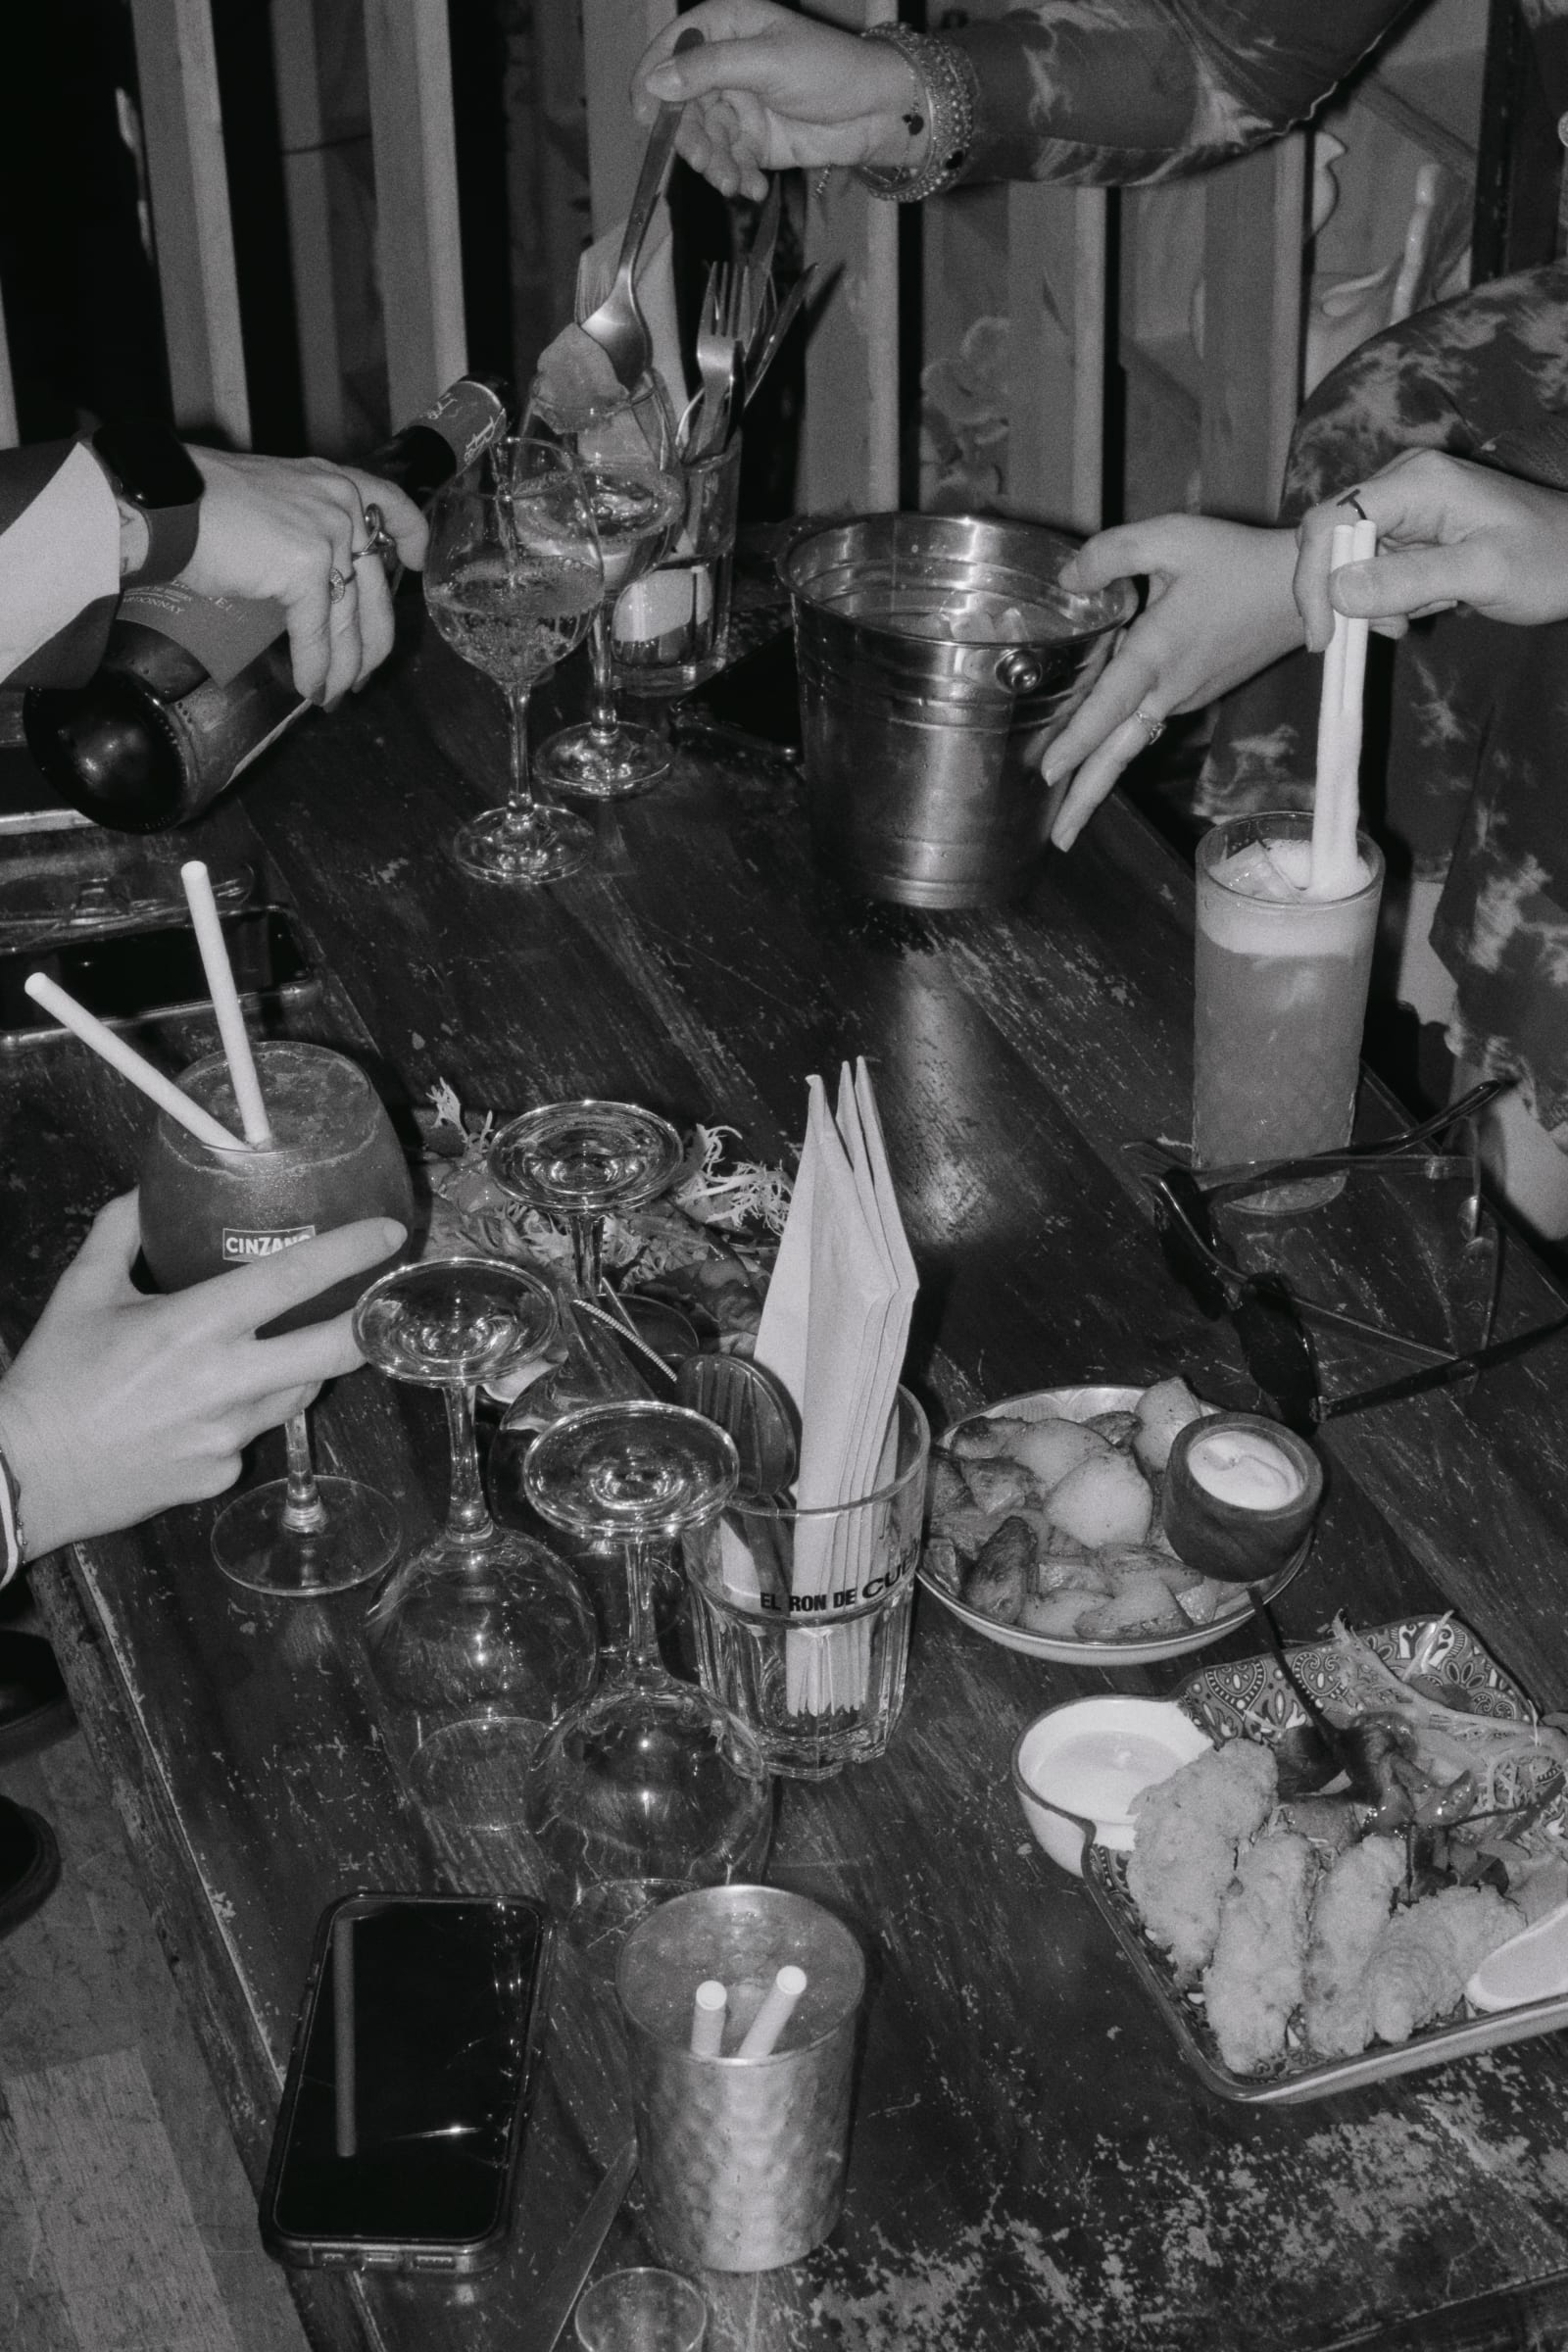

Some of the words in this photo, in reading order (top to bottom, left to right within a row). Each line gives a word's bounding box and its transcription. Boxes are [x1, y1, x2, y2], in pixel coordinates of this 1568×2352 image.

[760, 1592, 781, 1610] EL
[789, 1593, 827, 1612] RON
[833, 1588, 857, 1609] DE
